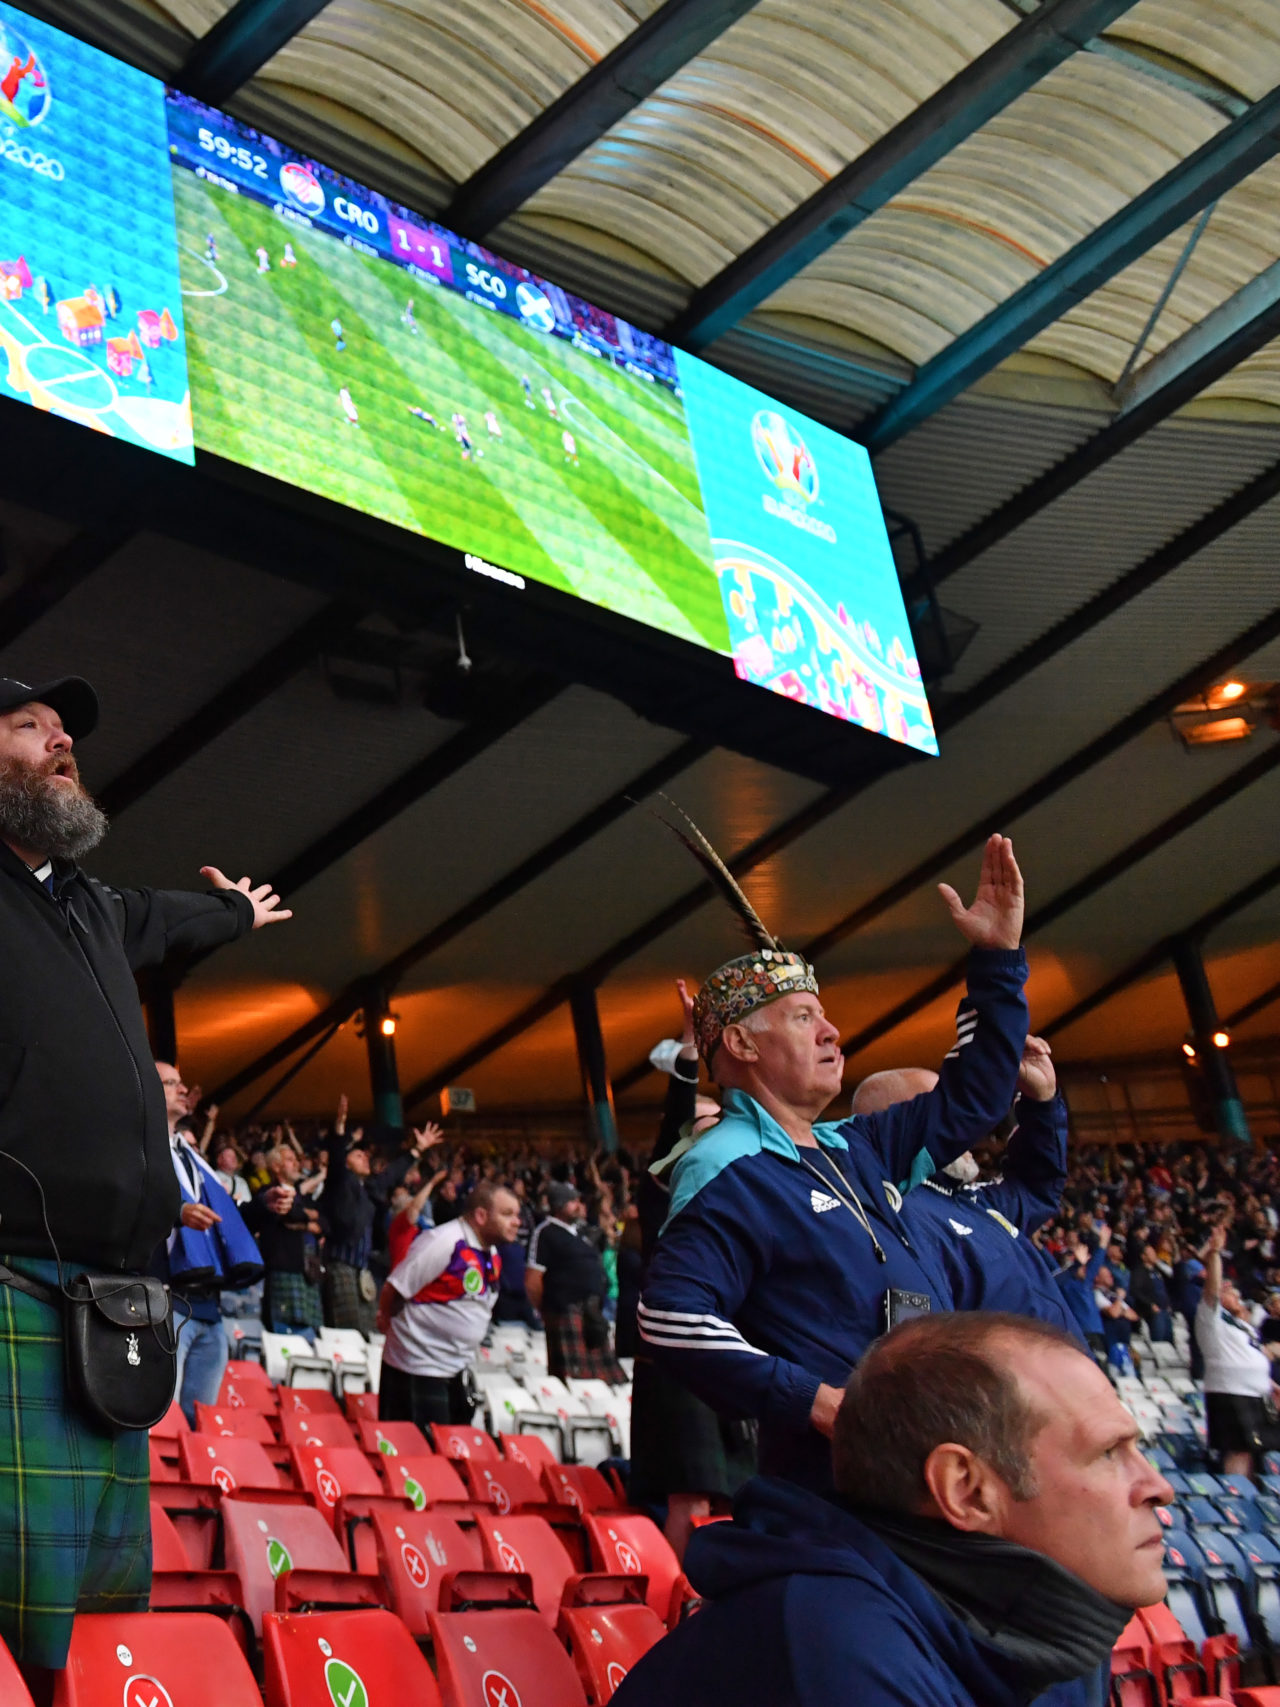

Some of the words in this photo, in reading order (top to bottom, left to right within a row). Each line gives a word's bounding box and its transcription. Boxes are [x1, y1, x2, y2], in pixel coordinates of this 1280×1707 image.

[198, 128, 268, 179] 59:52
[334, 197, 379, 234] CRO
[465, 263, 507, 299] SCO
